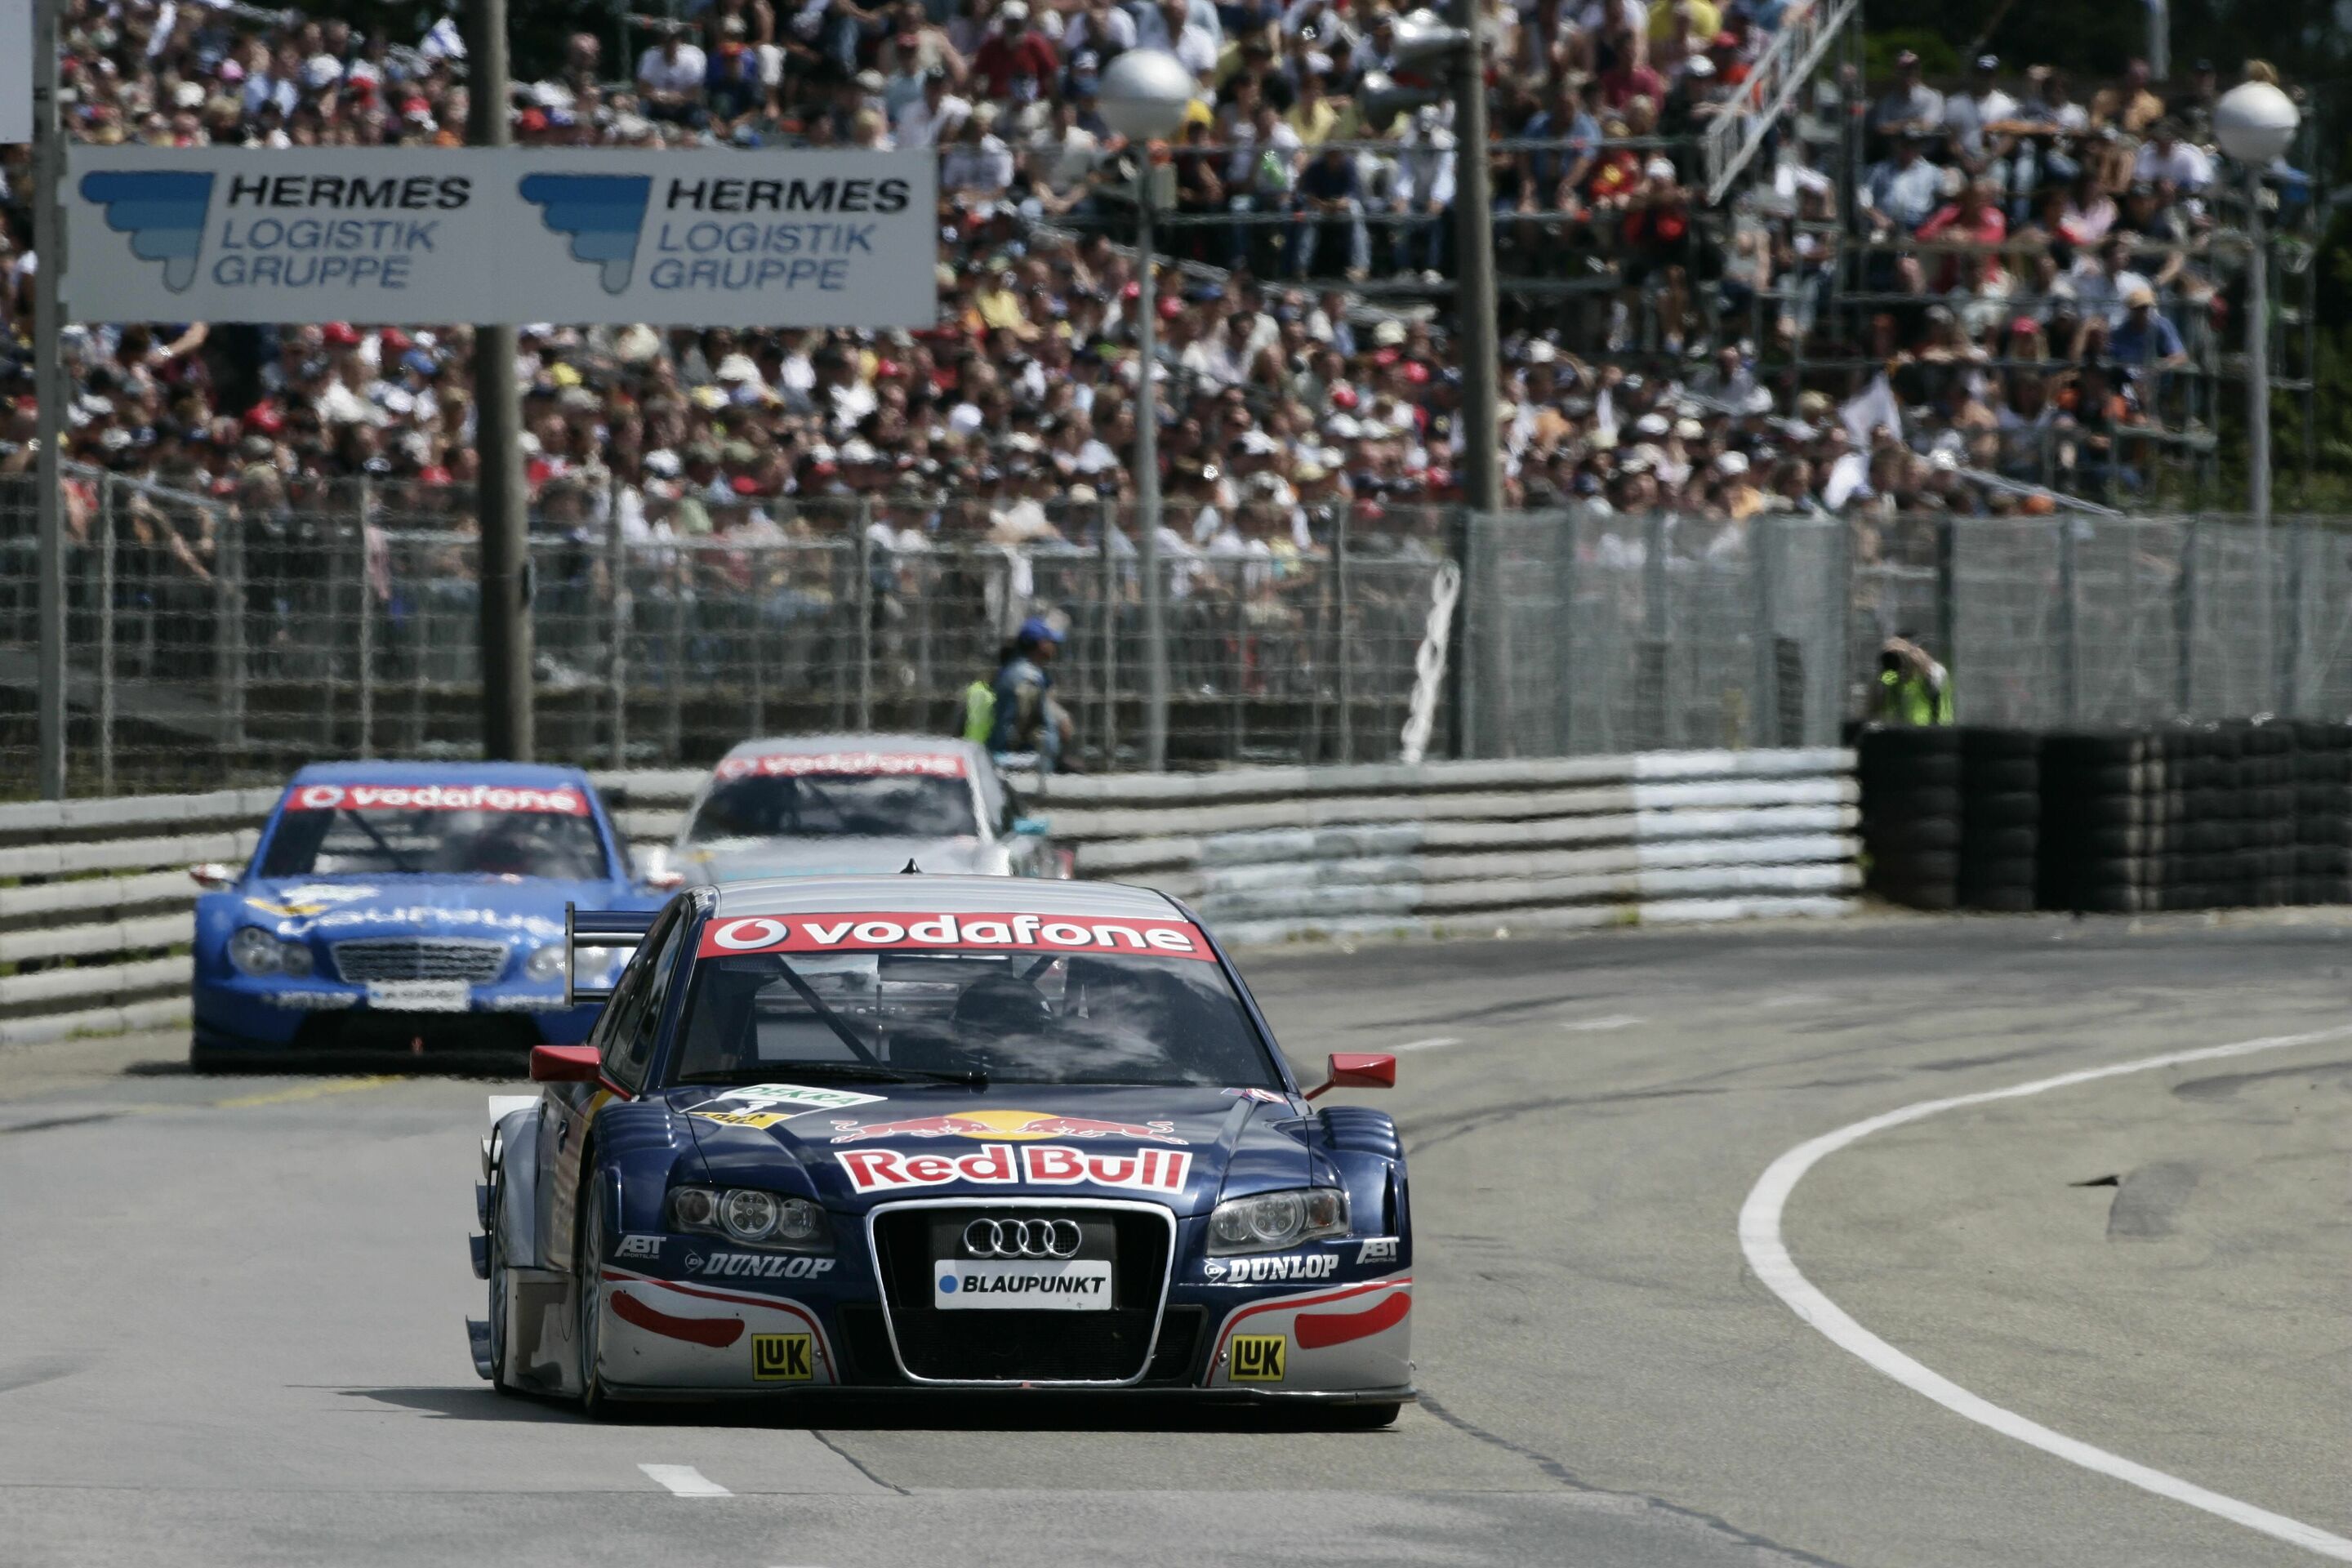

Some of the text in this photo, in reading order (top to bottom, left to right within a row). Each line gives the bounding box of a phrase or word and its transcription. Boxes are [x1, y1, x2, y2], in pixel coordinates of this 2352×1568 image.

[228, 175, 471, 210] HERMES
[664, 178, 911, 214] HERMES
[220, 218, 441, 252] LOGISTIK
[656, 221, 876, 256] LOGISTIK
[212, 255, 411, 289] GRUPPE
[650, 257, 847, 291] GRUPPE
[350, 784, 578, 811] vodafone
[801, 913, 1196, 953] vodafone
[735, 1087, 862, 1104] DEKRA
[841, 1145, 1191, 1193] Red Bull
[613, 1234, 667, 1258] ABT
[1356, 1236, 1401, 1265] ABT
[702, 1252, 836, 1280] DUNLOP
[1227, 1254, 1339, 1283] DUNLOP
[961, 1274, 1107, 1294] BLAUPUNKT
